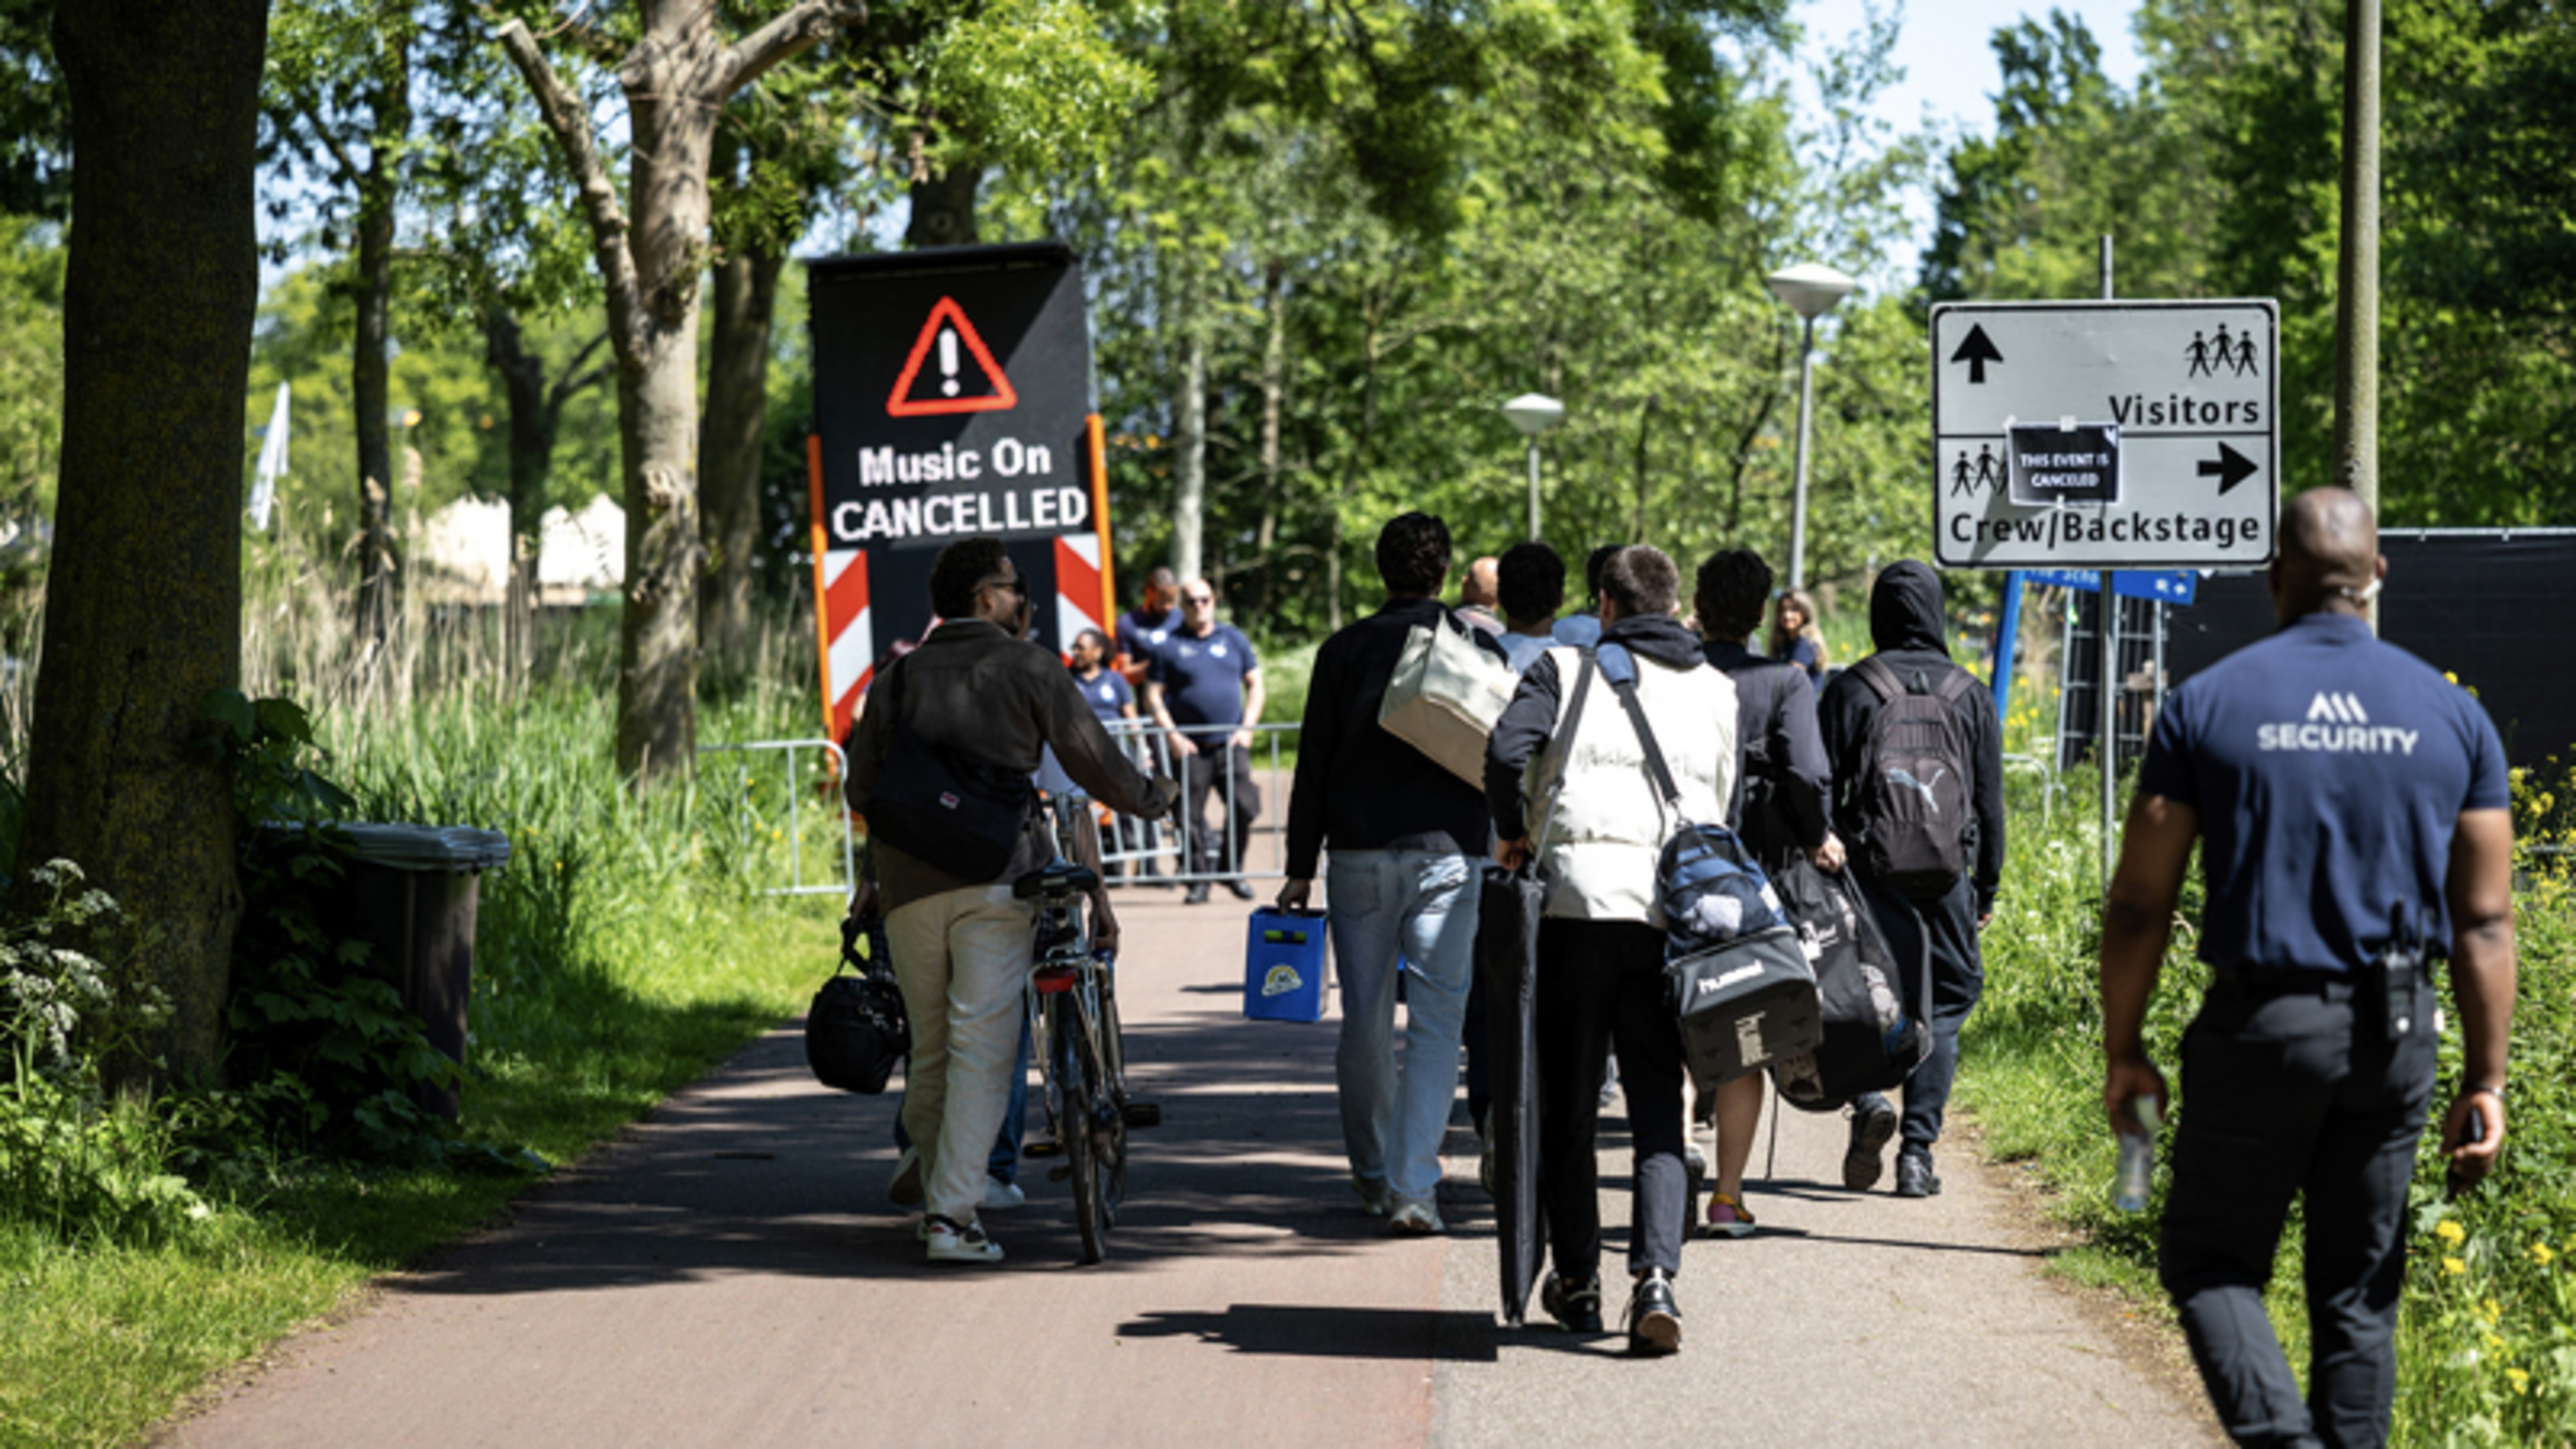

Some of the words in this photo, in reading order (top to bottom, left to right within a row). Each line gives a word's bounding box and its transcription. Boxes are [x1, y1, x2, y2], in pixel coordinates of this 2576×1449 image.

[2109, 396, 2259, 426] Visitors
[859, 441, 980, 486] Music
[991, 437, 1051, 477] On
[2020, 453, 2049, 468] THIS
[2053, 453, 2094, 468] EVENT
[2096, 453, 2110, 468] IS
[833, 486, 1089, 542] CANCELLED
[1951, 511, 2259, 550] Crew/Backstage
[2257, 722, 2419, 757] SECURITY
